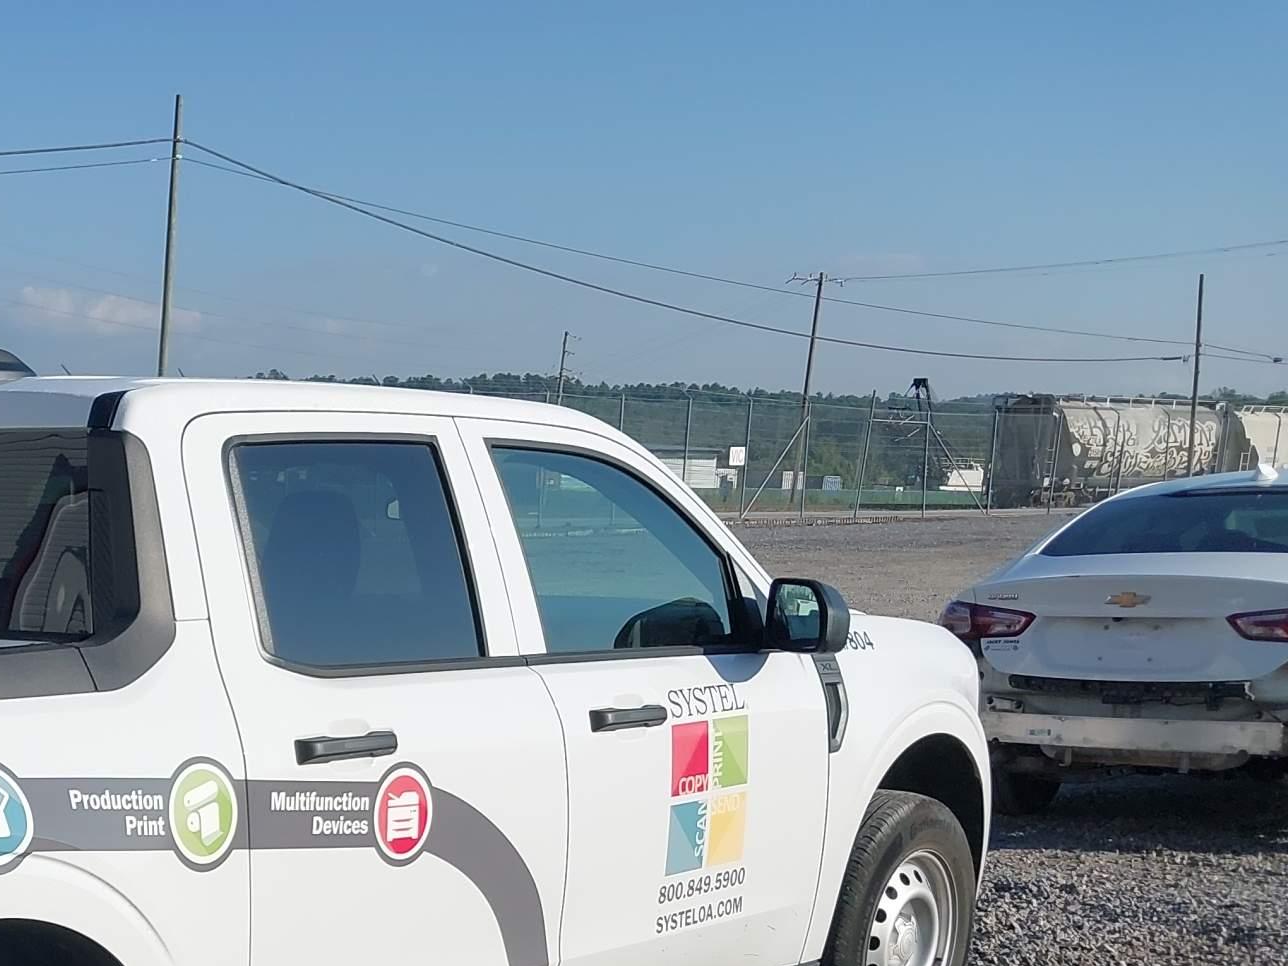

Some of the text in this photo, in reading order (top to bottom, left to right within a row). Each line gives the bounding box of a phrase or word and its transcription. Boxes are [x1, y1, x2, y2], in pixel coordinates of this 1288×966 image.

[820, 661, 834, 672] XL
[667, 683, 746, 719] SYSTEL
[711, 727, 724, 789] PRINT
[679, 773, 712, 796] COPY
[68, 788, 164, 811] Production
[269, 791, 370, 812] Multifunction
[125, 815, 166, 837] Print
[311, 815, 369, 836] Devices
[694, 799, 709, 857] SCAN
[657, 867, 746, 904] 800.849.5900
[655, 896, 743, 934] SYSTELOA.COM
